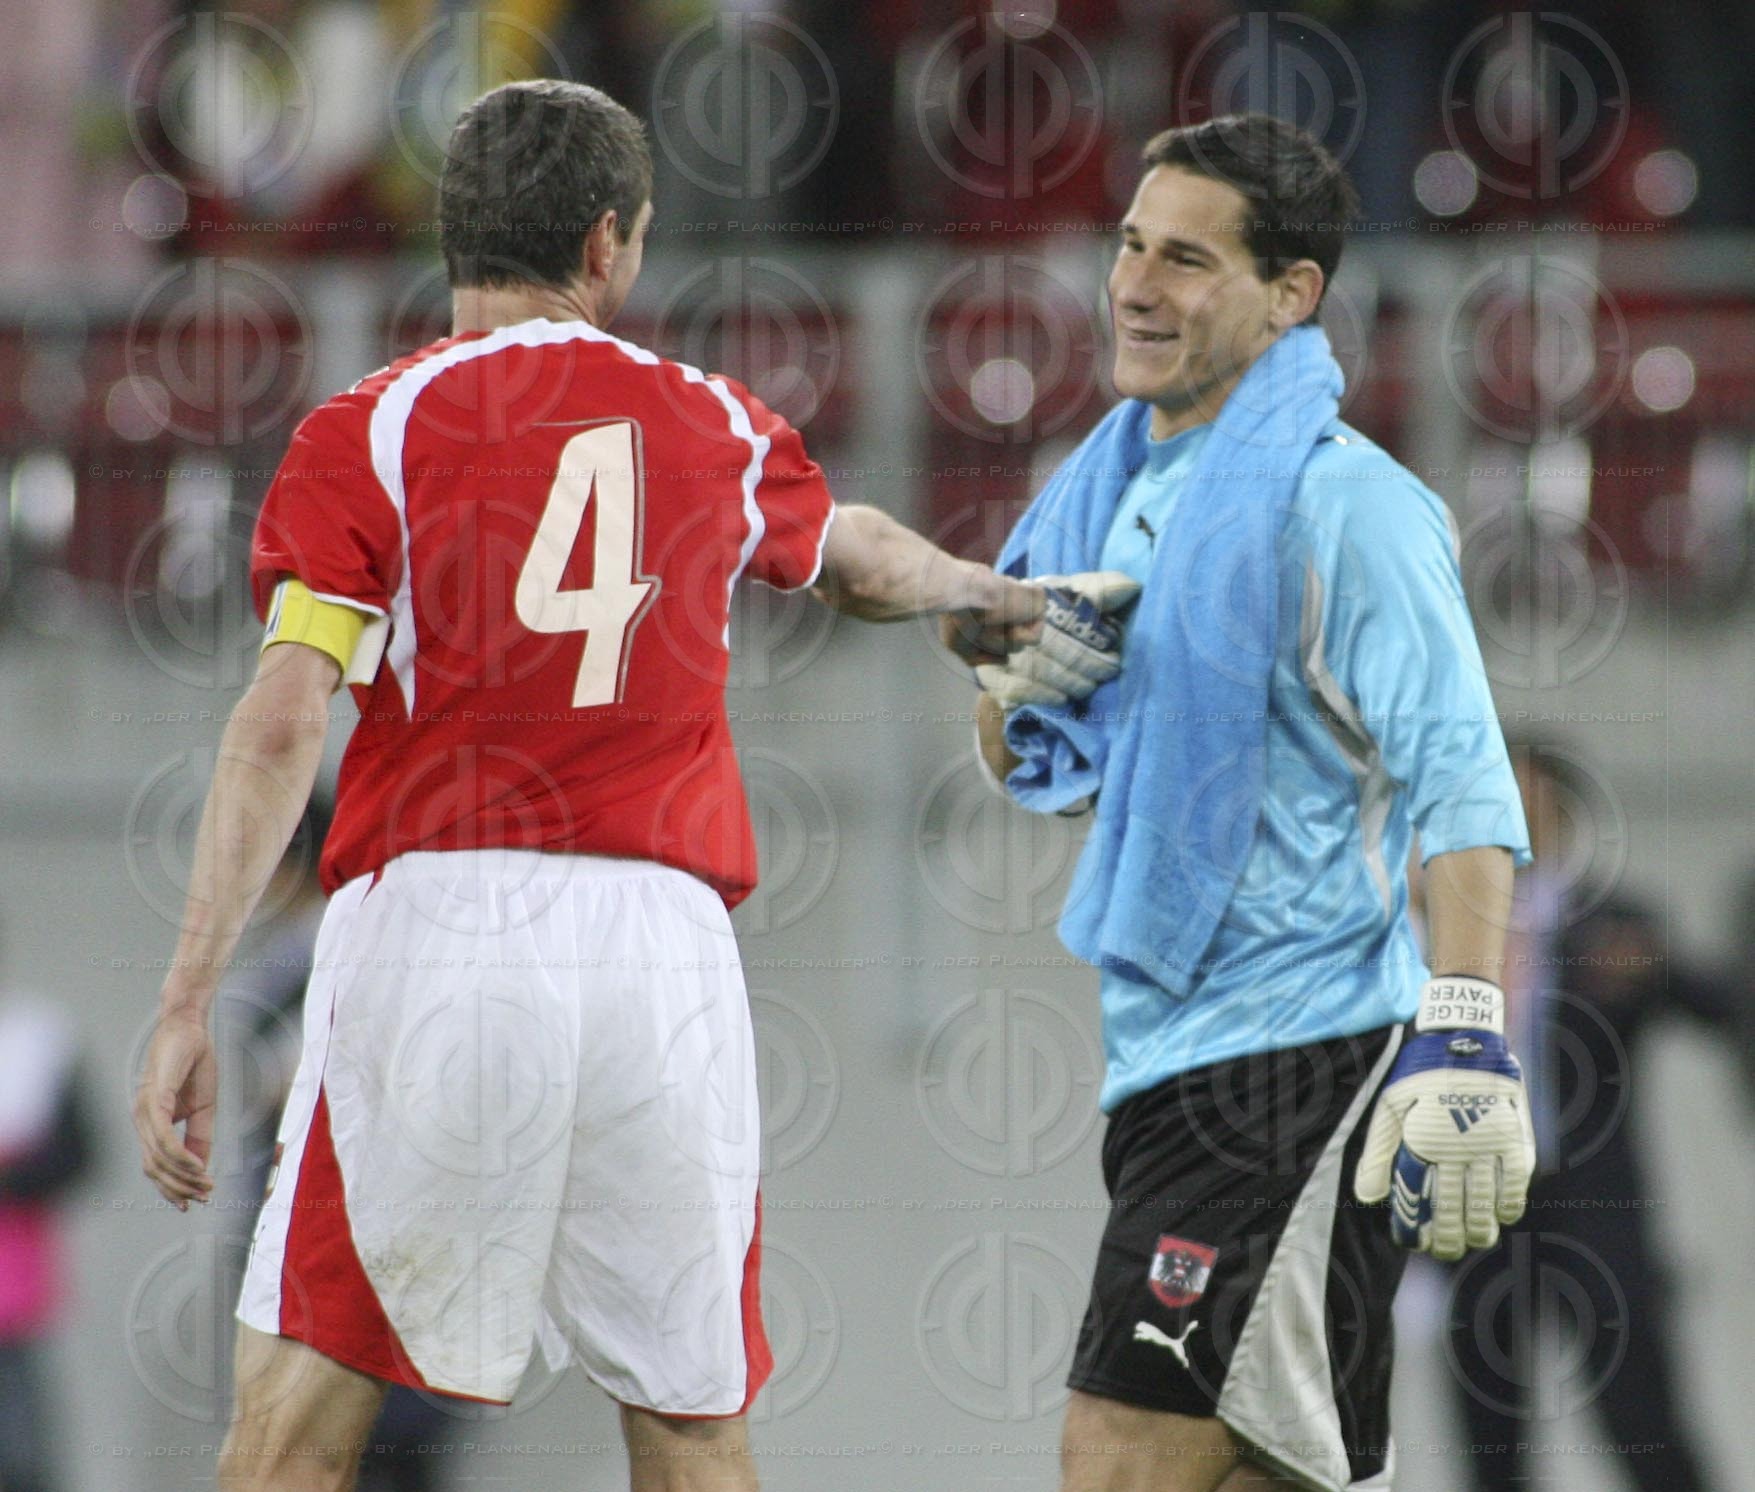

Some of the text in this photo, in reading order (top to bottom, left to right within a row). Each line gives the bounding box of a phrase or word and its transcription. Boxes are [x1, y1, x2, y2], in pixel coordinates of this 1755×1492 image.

[516, 419, 656, 708] 4
[1429, 985, 1492, 1005] PAYER
[1426, 1004, 1493, 1024] HELGE
[1438, 1093, 1498, 1108] adidas
